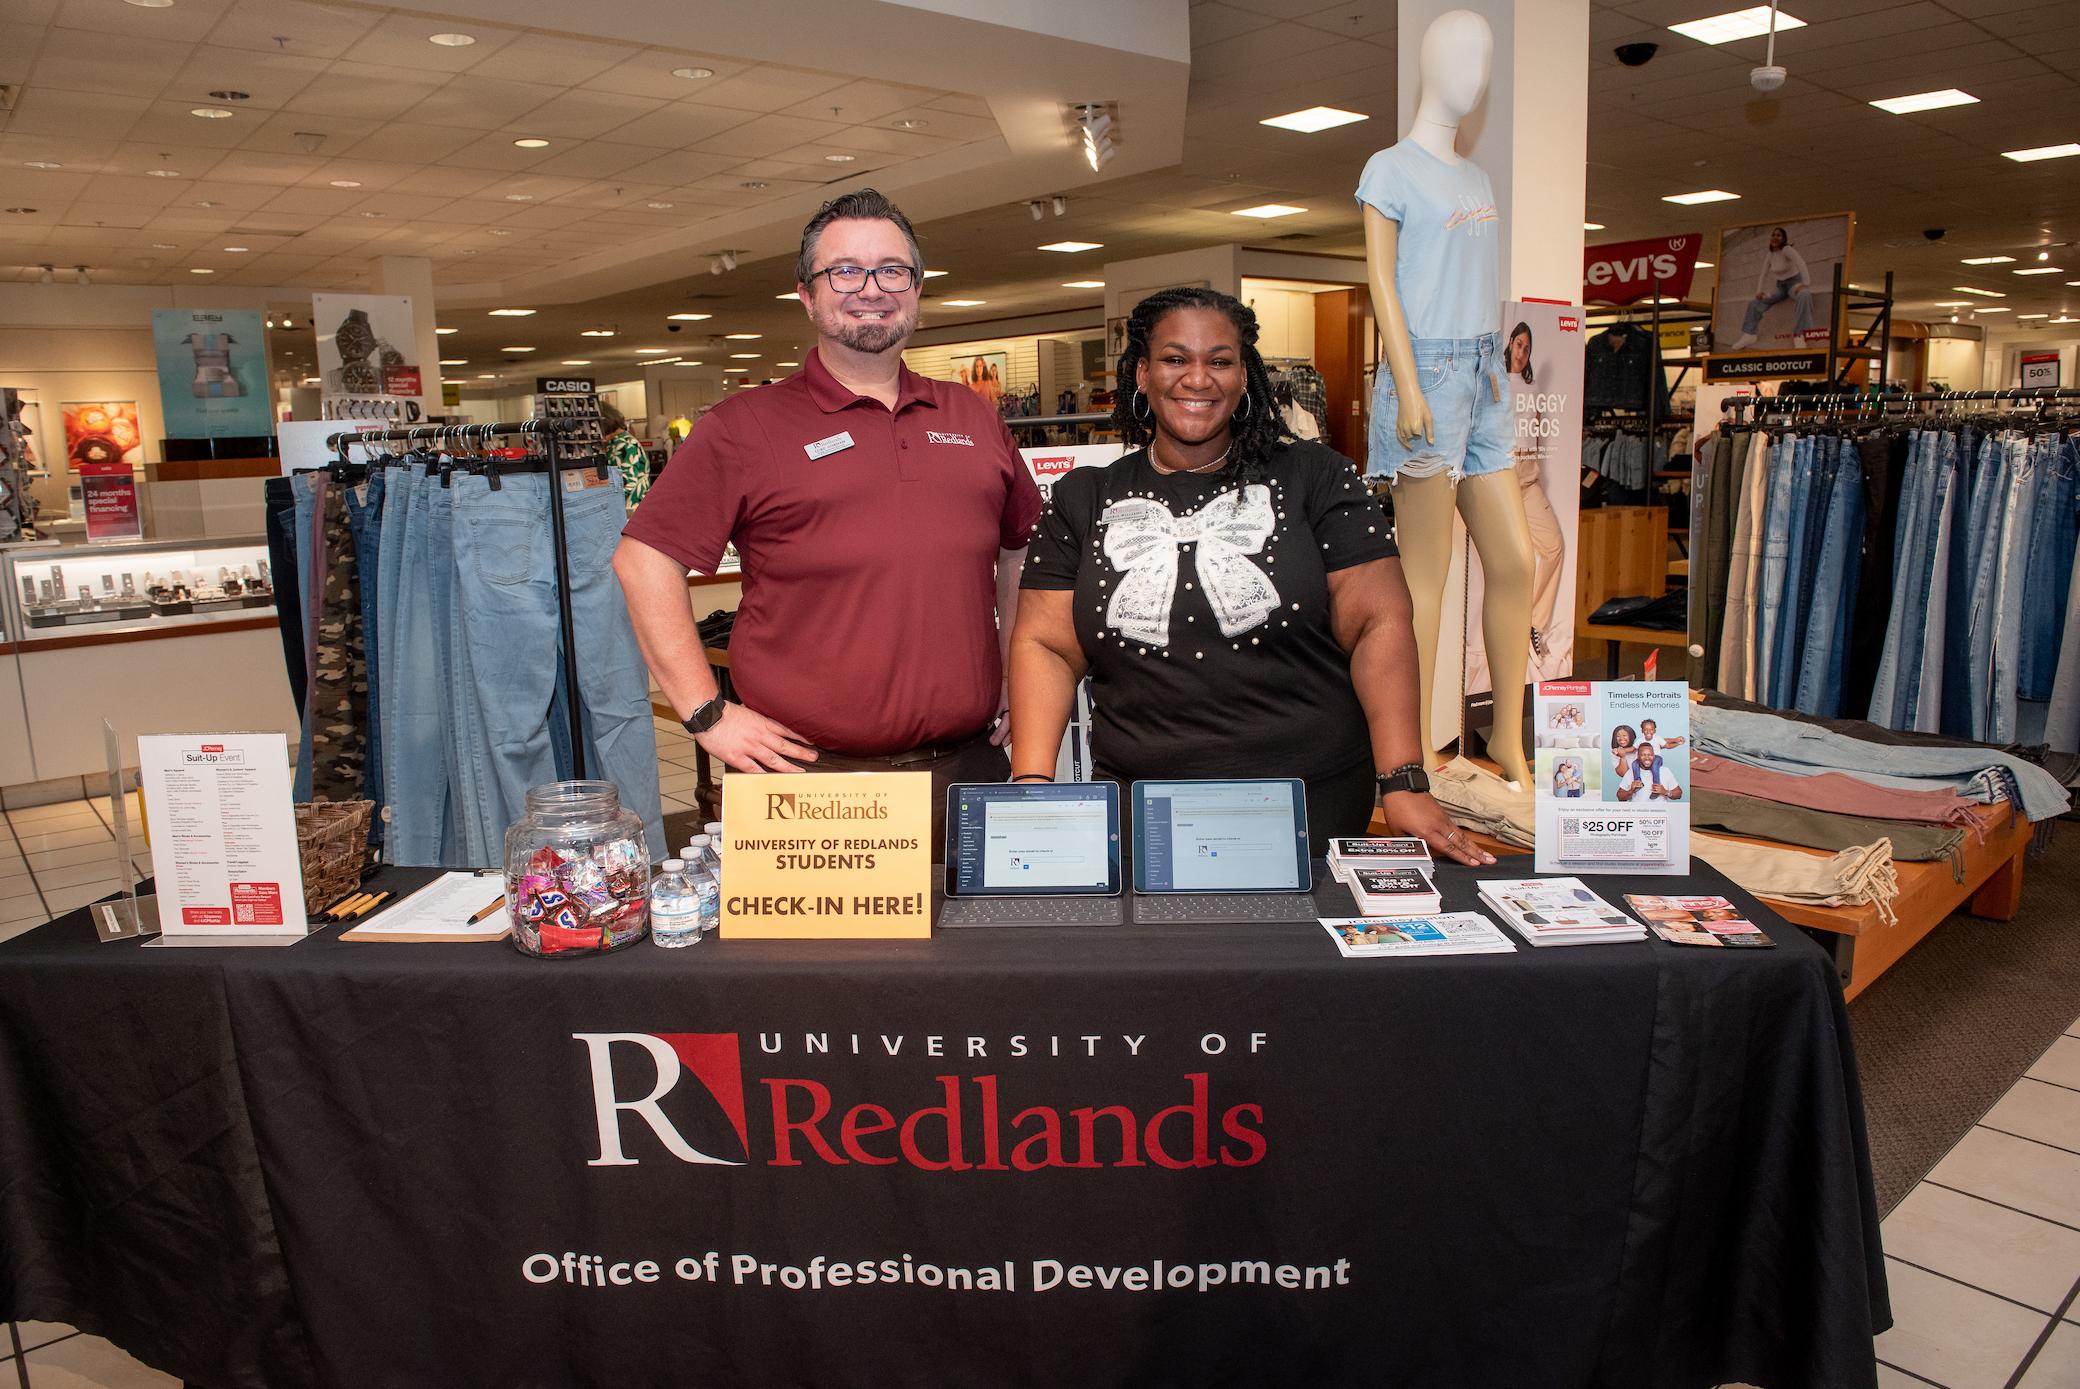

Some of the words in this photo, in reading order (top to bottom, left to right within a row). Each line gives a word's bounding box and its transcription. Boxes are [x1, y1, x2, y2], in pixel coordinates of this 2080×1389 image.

[1722, 362, 1763, 374] CLASSIC
[1765, 360, 1813, 372] BOOTCUT
[545, 380, 592, 393] CASIO
[1516, 393, 1568, 413] BAGGY
[1514, 418, 1560, 438] RGOS
[87, 490, 98, 498] 24
[100, 489, 131, 497] months
[88, 497, 118, 506] special
[89, 505, 129, 513] financing
[1608, 691, 1645, 699] Timeless
[1646, 691, 1682, 699] Portraits
[1609, 701, 1641, 709] Endless
[1642, 701, 1681, 709] Memories
[186, 753, 218, 764] Suit-Up
[219, 753, 241, 762] Event
[797, 801, 888, 820] Redlands
[1582, 820, 1604, 833] $25
[1606, 820, 1634, 832] OFF
[734, 839, 816, 851] UNIVERSITY
[821, 839, 840, 850] OF
[844, 838, 919, 850] REDLANDS
[775, 853, 876, 870] STUDENTS
[726, 896, 844, 916] CHECK-IN
[853, 892, 923, 915] HERE!
[759, 1031, 1150, 1058] UNIVERSITY
[1200, 1031, 1270, 1056] OF
[759, 1073, 1269, 1171] Redlands
[521, 1252, 661, 1289] Office
[675, 1251, 719, 1283] of
[732, 1252, 1016, 1292] Professional
[1033, 1258, 1352, 1293] Development
